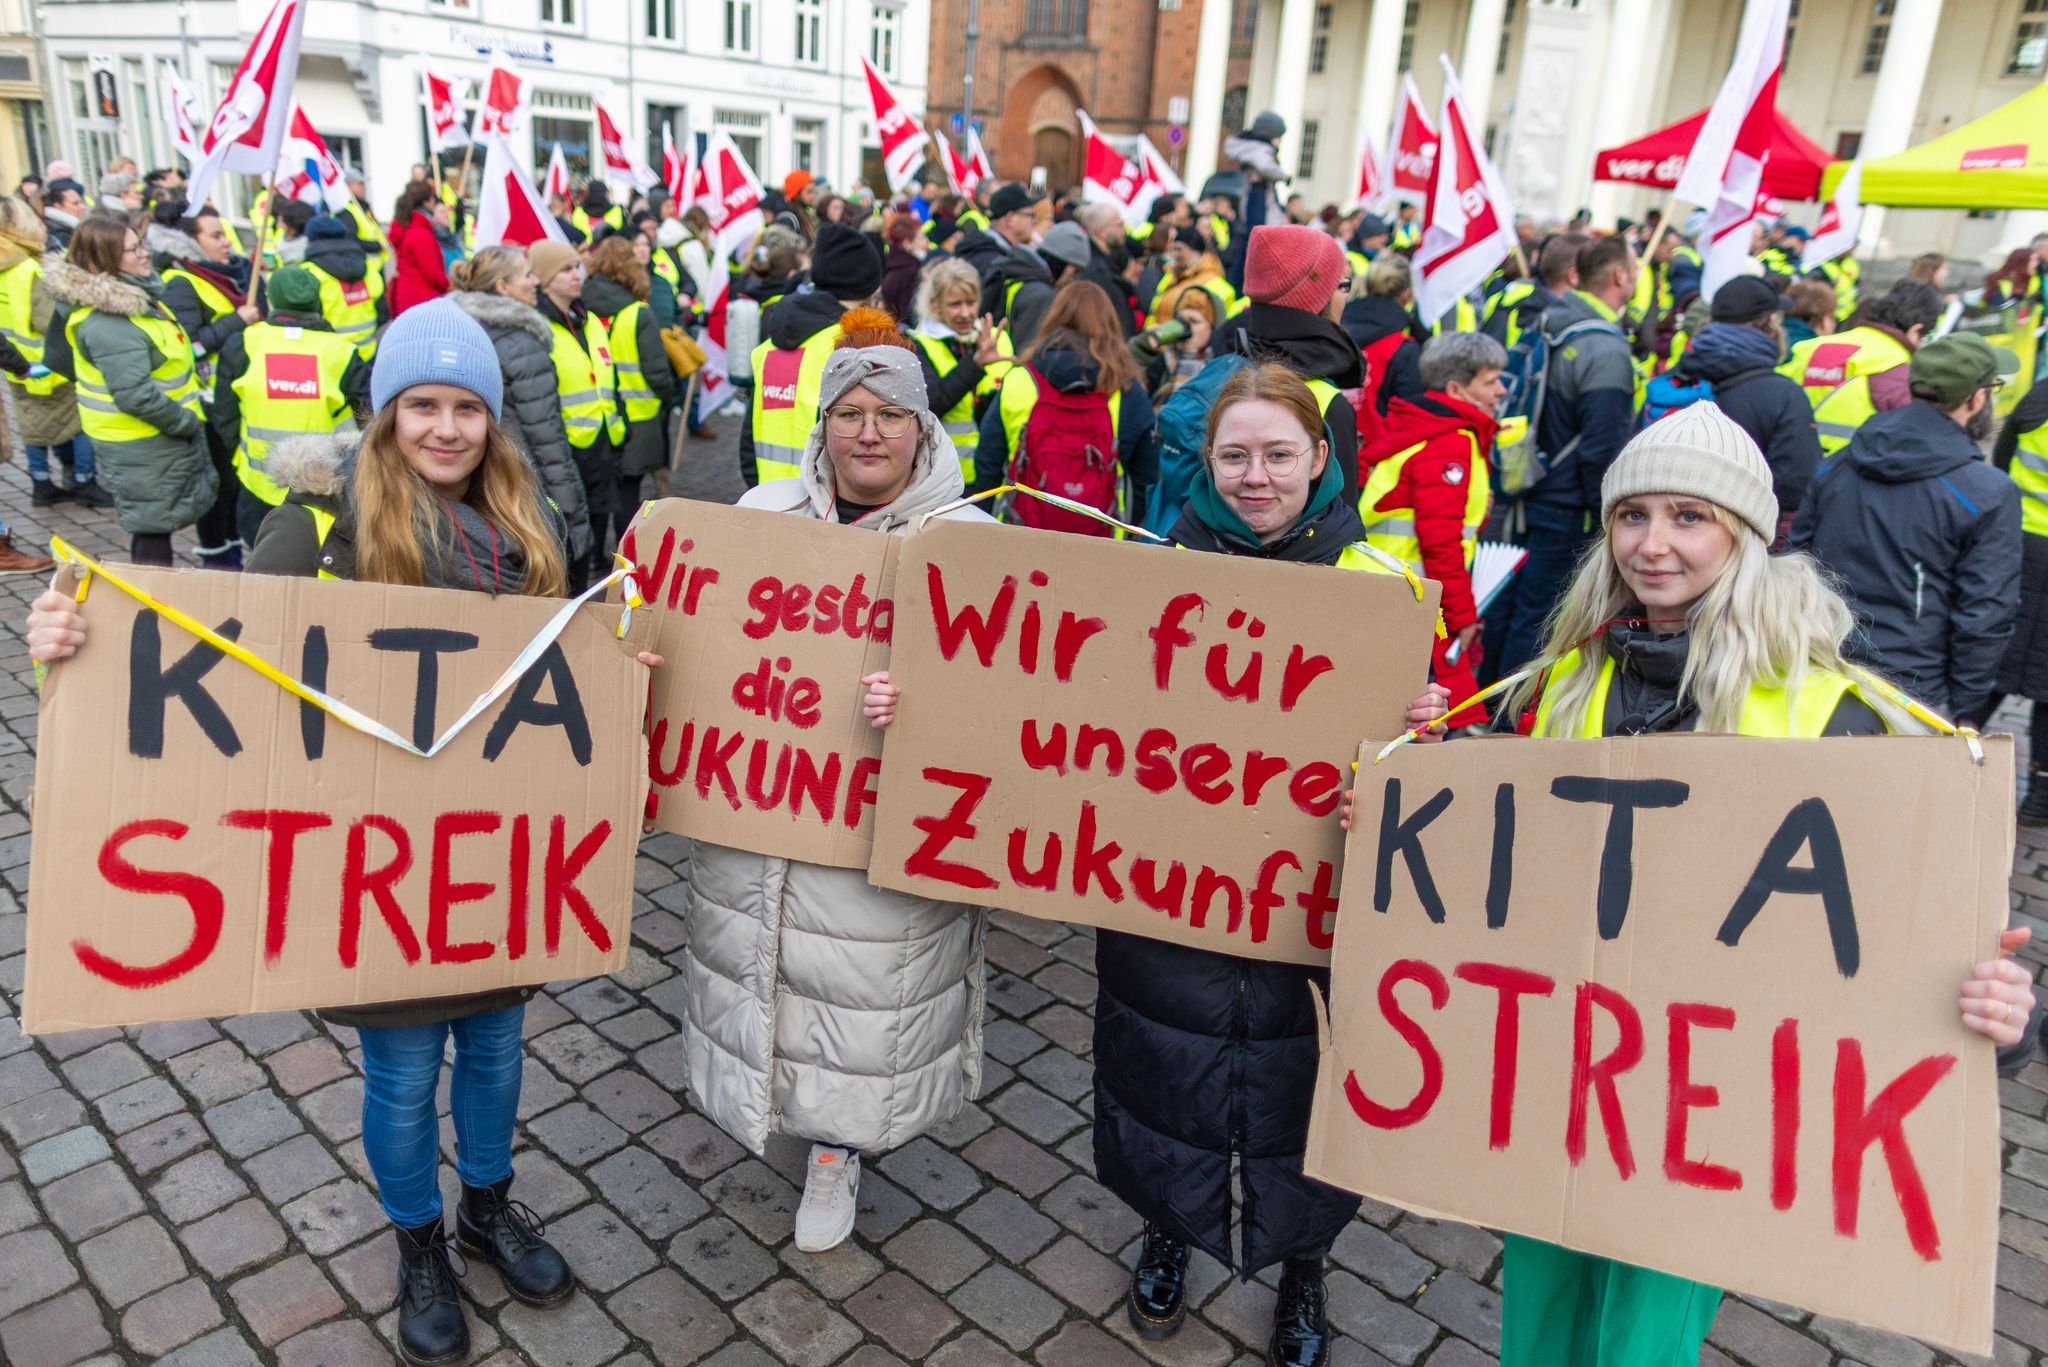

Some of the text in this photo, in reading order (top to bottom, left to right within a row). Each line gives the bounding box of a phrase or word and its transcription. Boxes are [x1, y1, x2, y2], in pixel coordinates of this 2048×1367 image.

[268, 378, 317, 395] ver.di
[762, 384, 796, 401] ver.di
[128, 609, 593, 767] KITA
[731, 656, 822, 729] die
[926, 562, 1336, 712] Wir für
[645, 715, 882, 830] UKUNF
[1020, 718, 1344, 818] unsere
[71, 809, 613, 989] STREIK
[904, 766, 1340, 950] Zukunft
[1373, 775, 1861, 978] KITA
[1343, 958, 1958, 1263] STREIK
